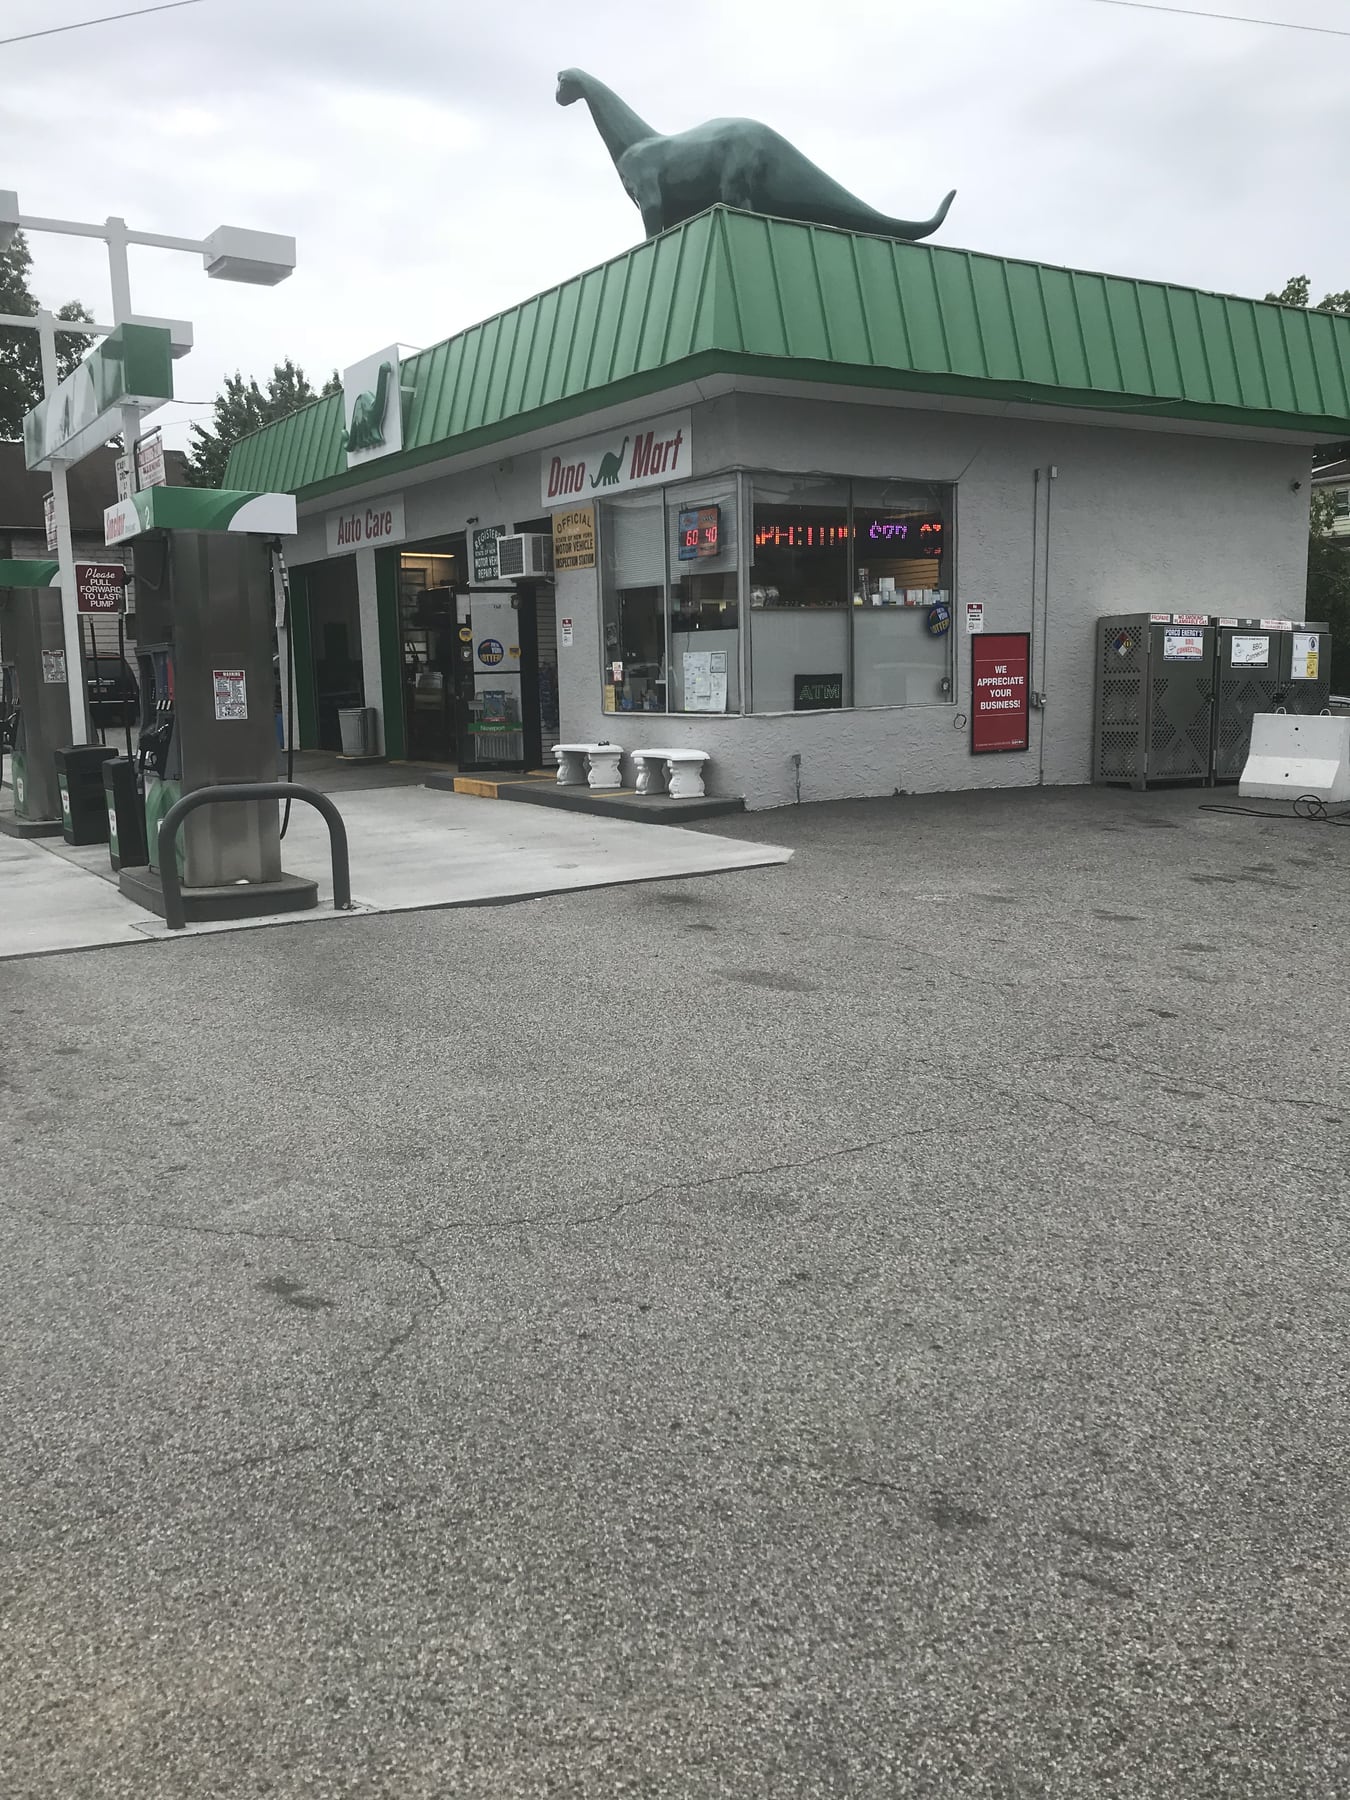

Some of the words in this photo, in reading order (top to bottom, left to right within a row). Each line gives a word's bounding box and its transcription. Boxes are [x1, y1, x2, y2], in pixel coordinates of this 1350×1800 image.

[548, 456, 586, 498] Dino
[630, 428, 683, 480] Mart
[144, 505, 151, 530] 2
[556, 512, 592, 534] OFFICIAL
[337, 513, 362, 545] Auto
[365, 508, 392, 539] Care
[474, 528, 502, 550] REGISTER
[686, 529, 699, 546] 60
[705, 526, 718, 543] 40
[555, 542, 572, 555] MOTOR
[572, 538, 594, 552] VEHICLE
[555, 556, 579, 569] INSPECTION
[579, 553, 594, 566] STATION
[85, 567, 116, 579] Please
[90, 578, 112, 586] PULL
[80, 585, 122, 593] FORWARD
[83, 592, 96, 600] TO
[97, 593, 121, 601] LAST
[90, 600, 114, 608] PUMP
[479, 653, 503, 664] OTTER
[994, 665, 1008, 674] WE
[976, 676, 1025, 687] APPRECIATE
[799, 684, 840, 700] ATM
[989, 688, 1012, 698] YOUR
[980, 699, 1021, 711] BUSINESS!
